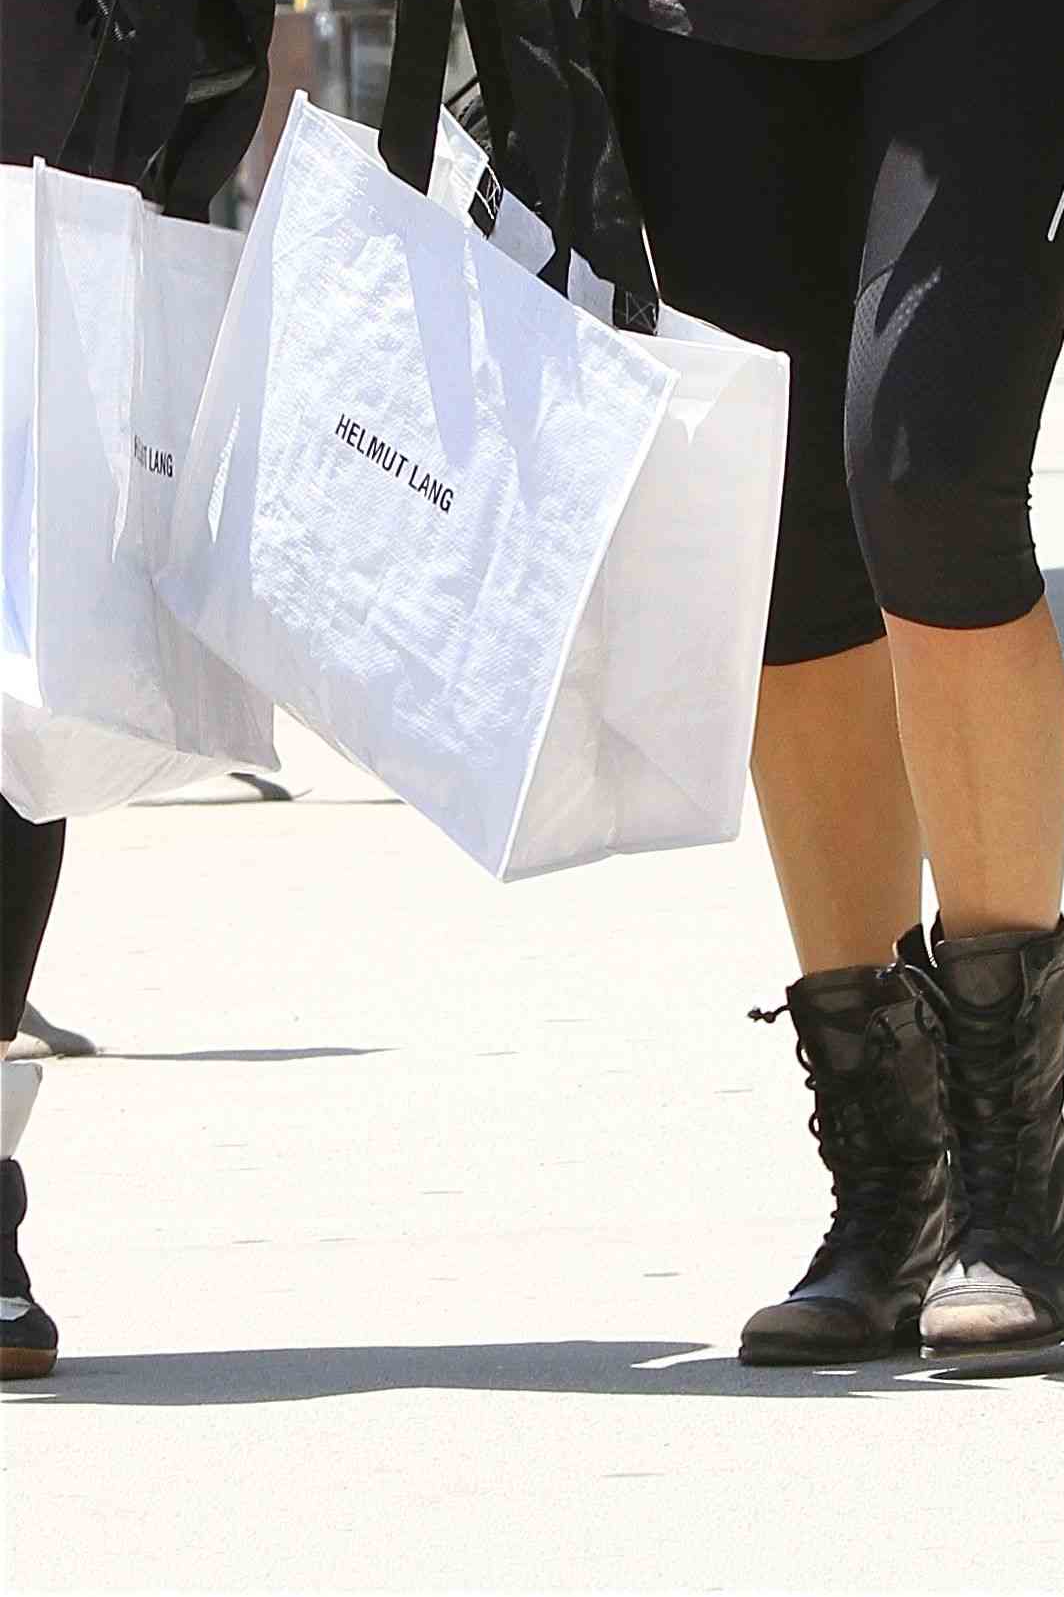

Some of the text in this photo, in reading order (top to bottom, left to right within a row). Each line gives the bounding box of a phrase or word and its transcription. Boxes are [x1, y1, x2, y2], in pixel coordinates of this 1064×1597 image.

[148, 446, 173, 478] LANG
[335, 413, 454, 515] HELMUT LANG
